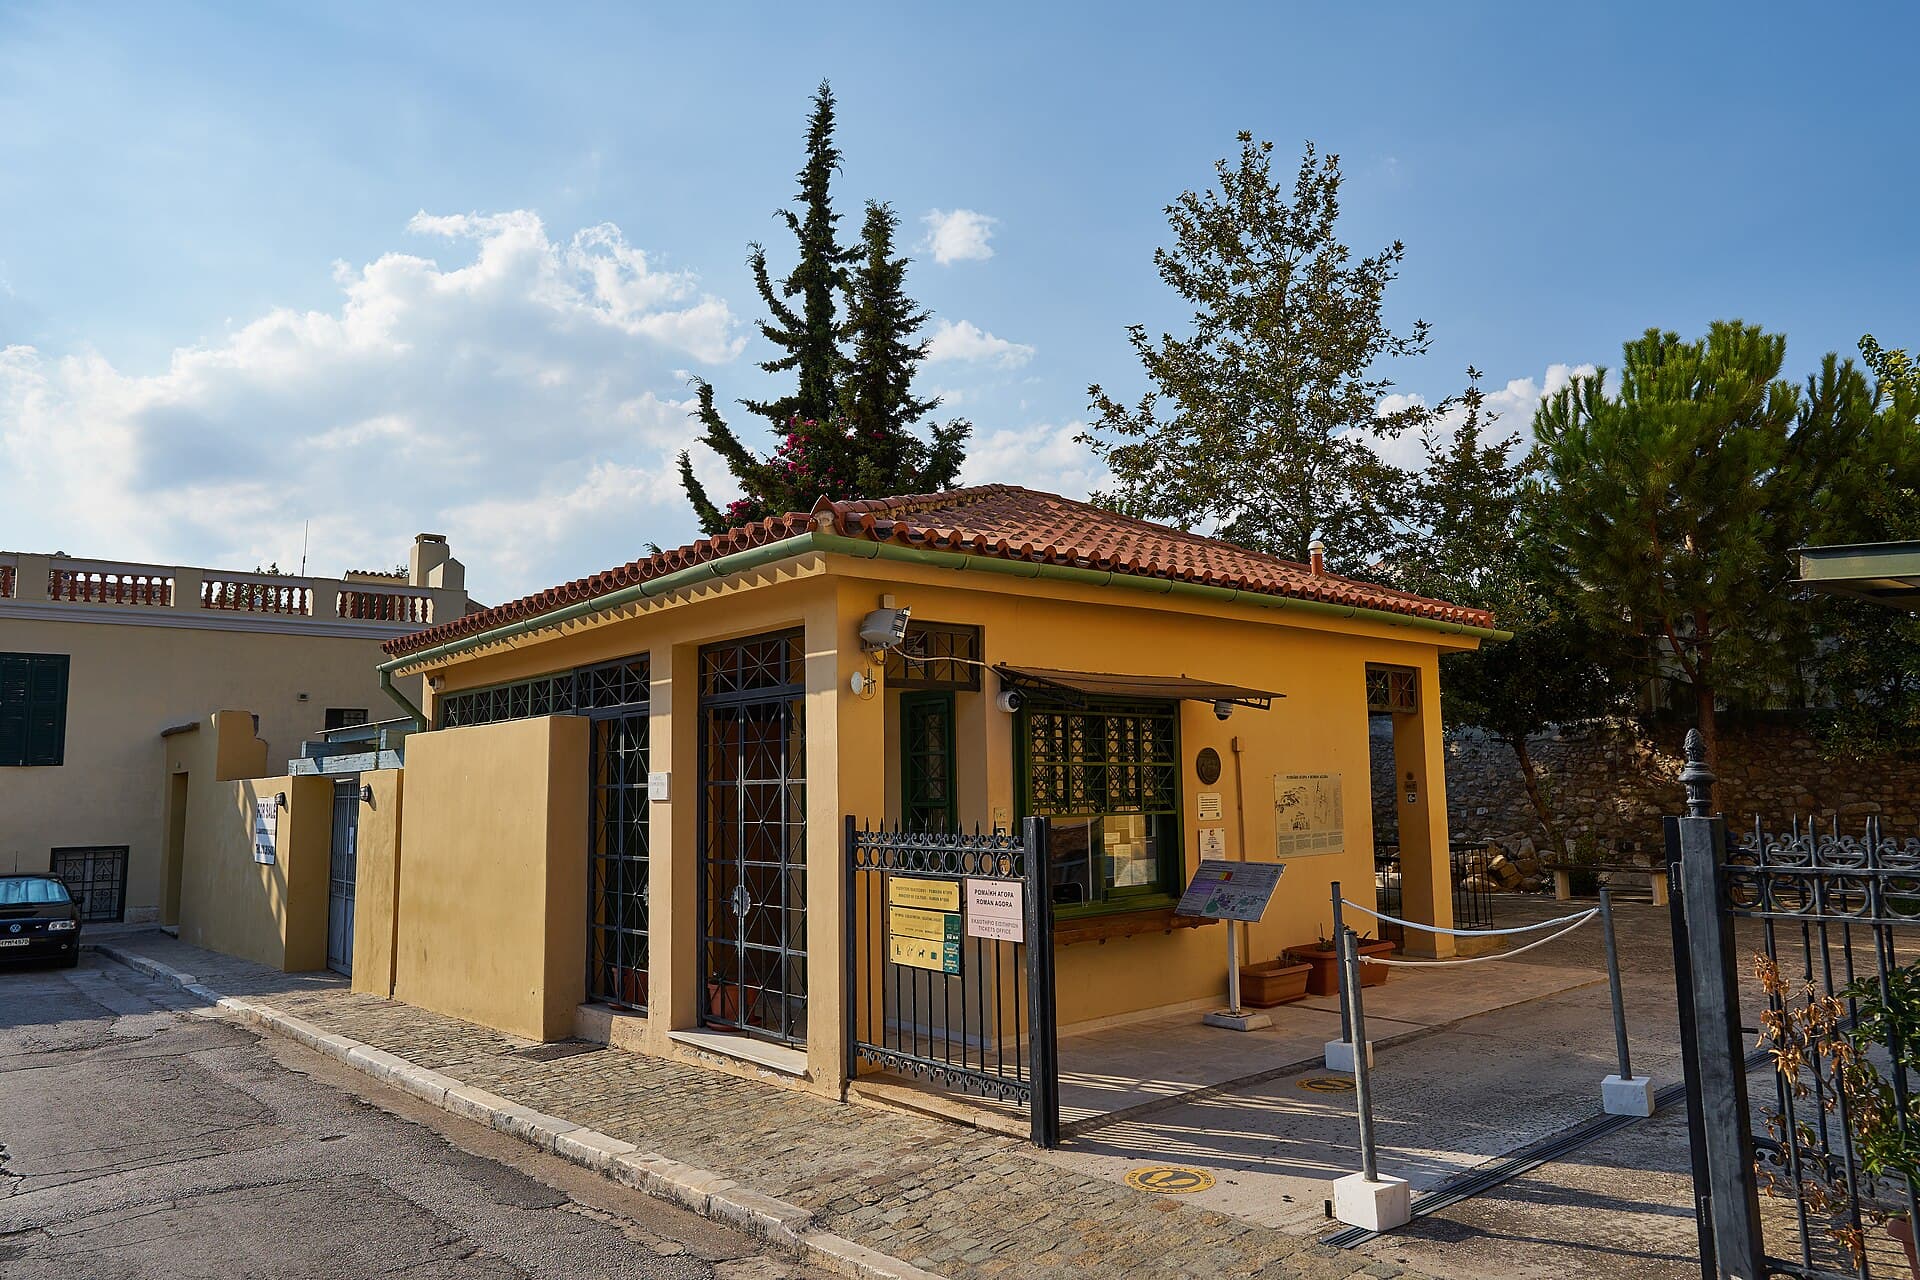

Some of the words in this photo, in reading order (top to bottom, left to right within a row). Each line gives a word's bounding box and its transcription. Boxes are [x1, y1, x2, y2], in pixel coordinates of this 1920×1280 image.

[256, 802, 266, 819] FOR
[266, 803, 277, 819] SALE
[976, 898, 994, 906] ROMAN
[978, 925, 995, 933] TICKETS
[996, 927, 1012, 935] OFFICE
